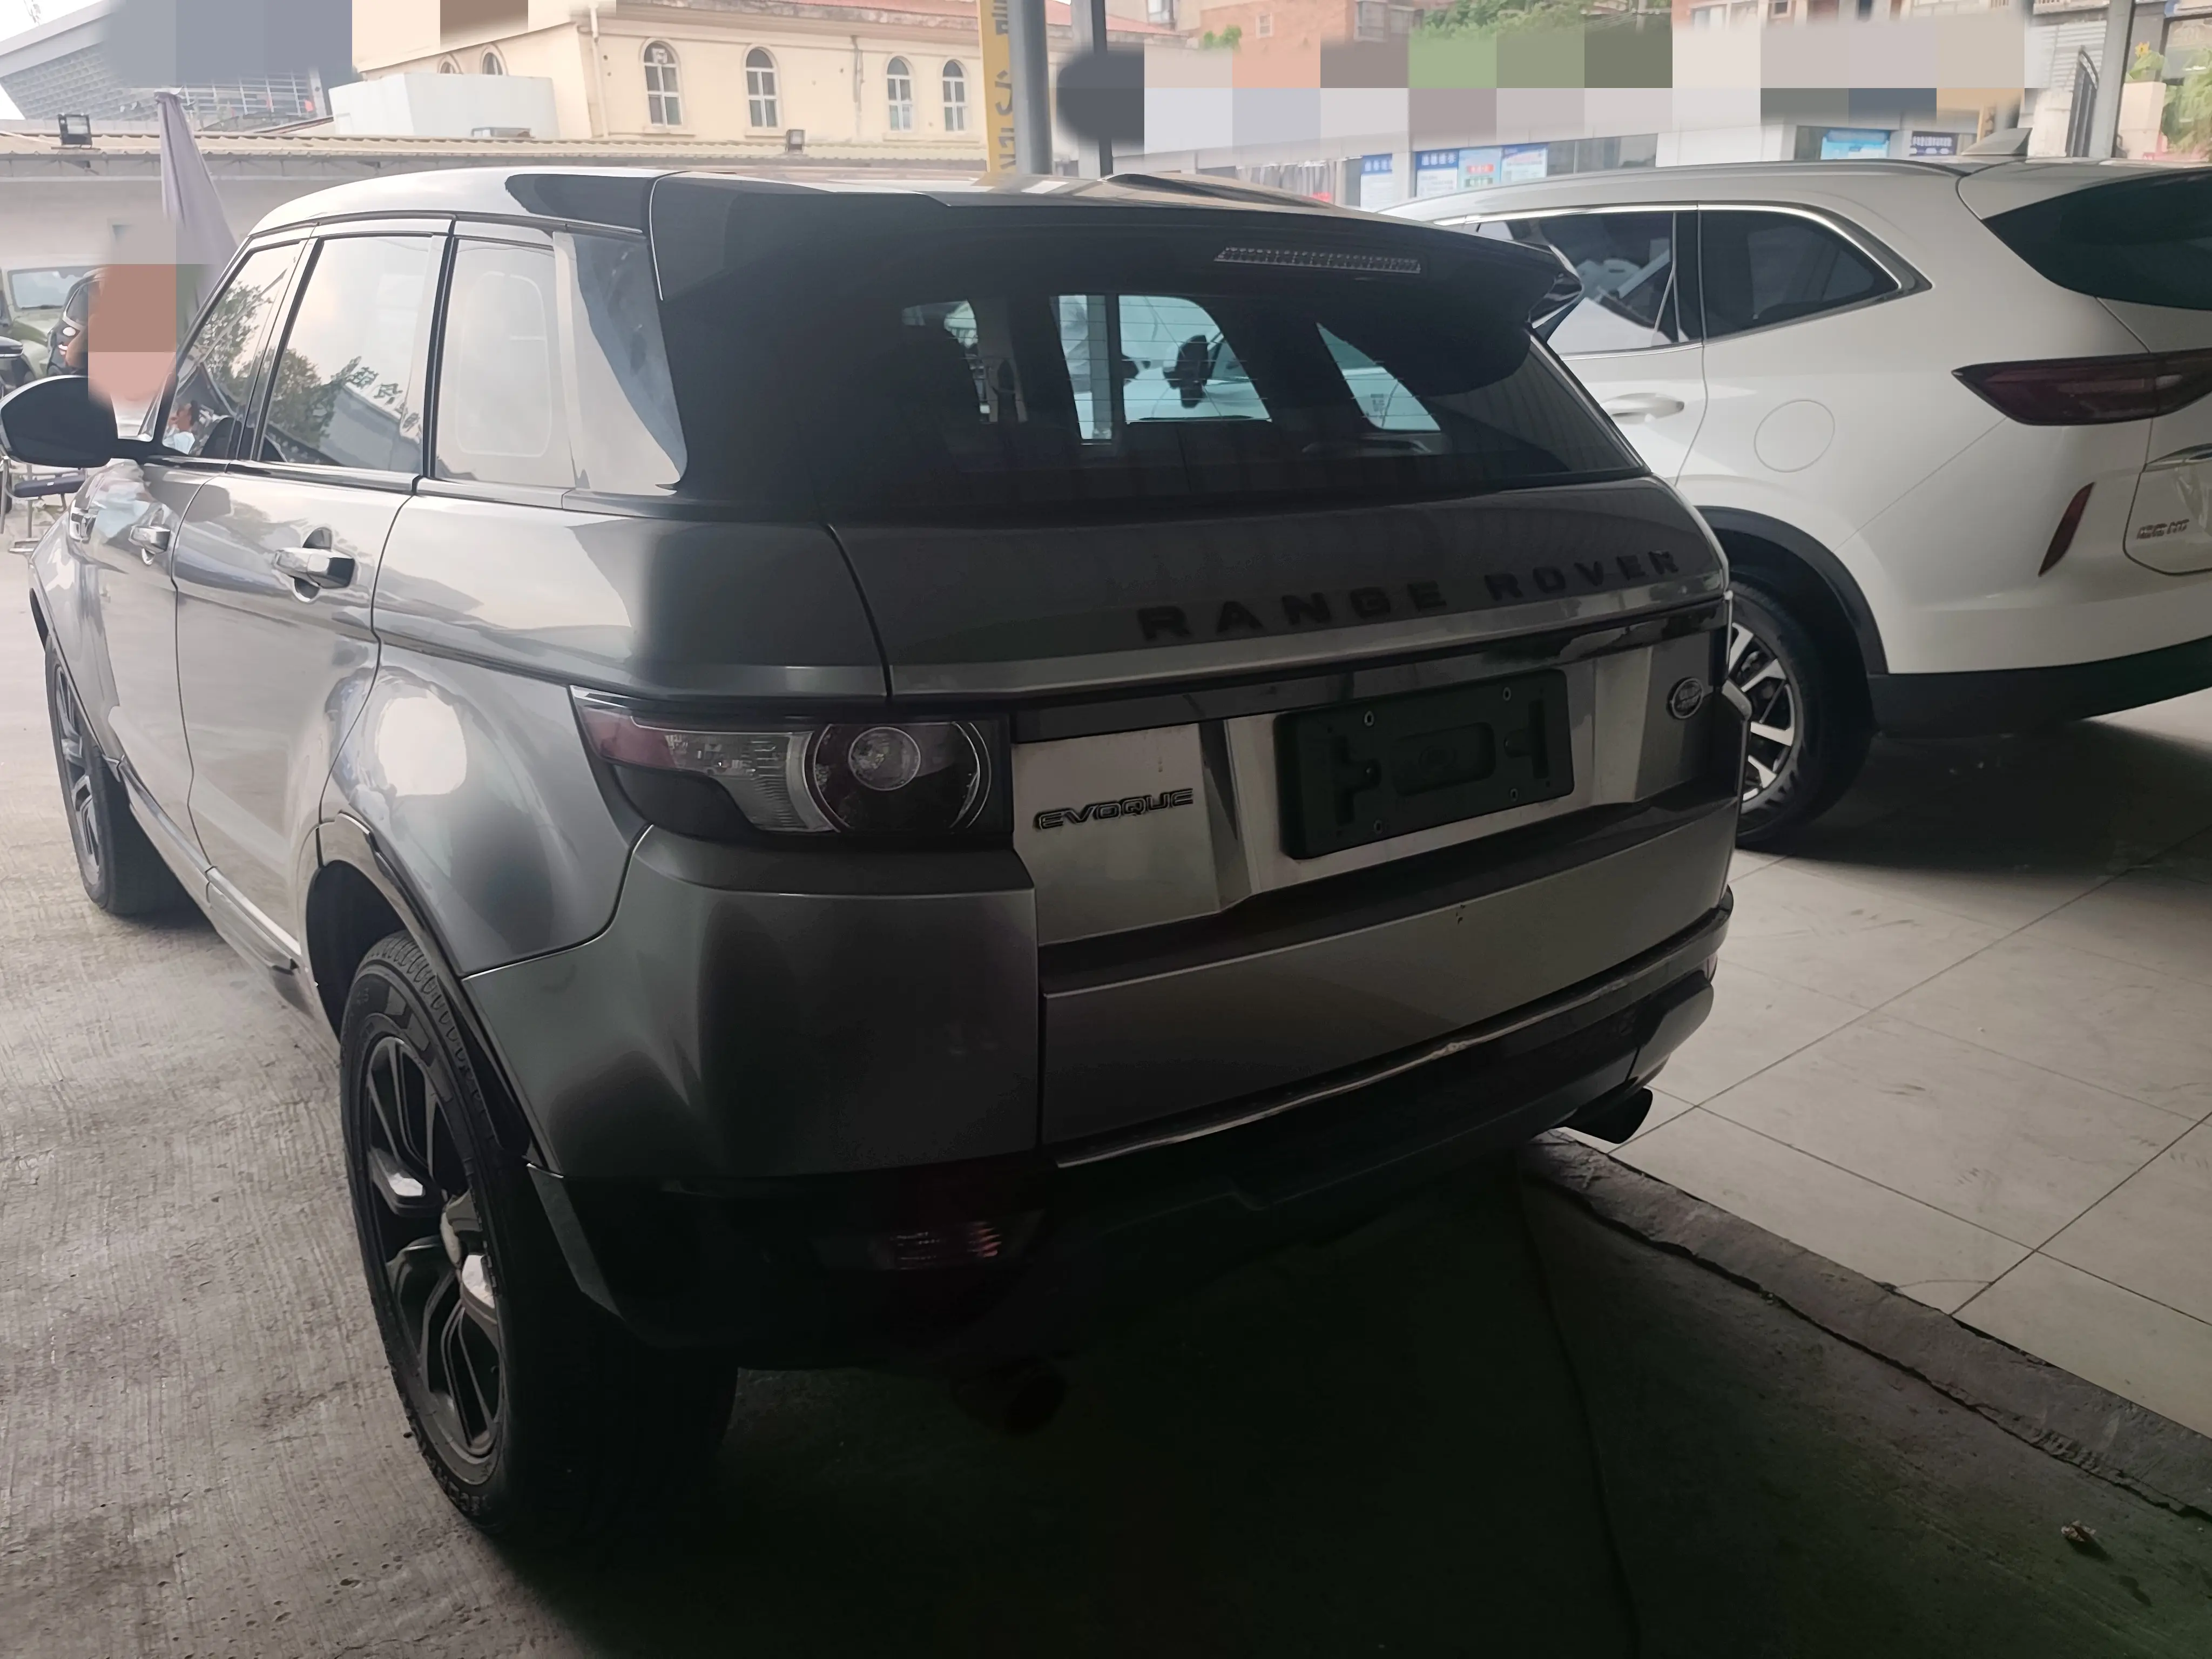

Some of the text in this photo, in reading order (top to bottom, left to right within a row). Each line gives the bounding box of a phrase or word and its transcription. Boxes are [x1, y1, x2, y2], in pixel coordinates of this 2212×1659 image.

[1137, 550, 1679, 642] RANGE ROVER
[1033, 788, 1193, 830] EVOQUE
